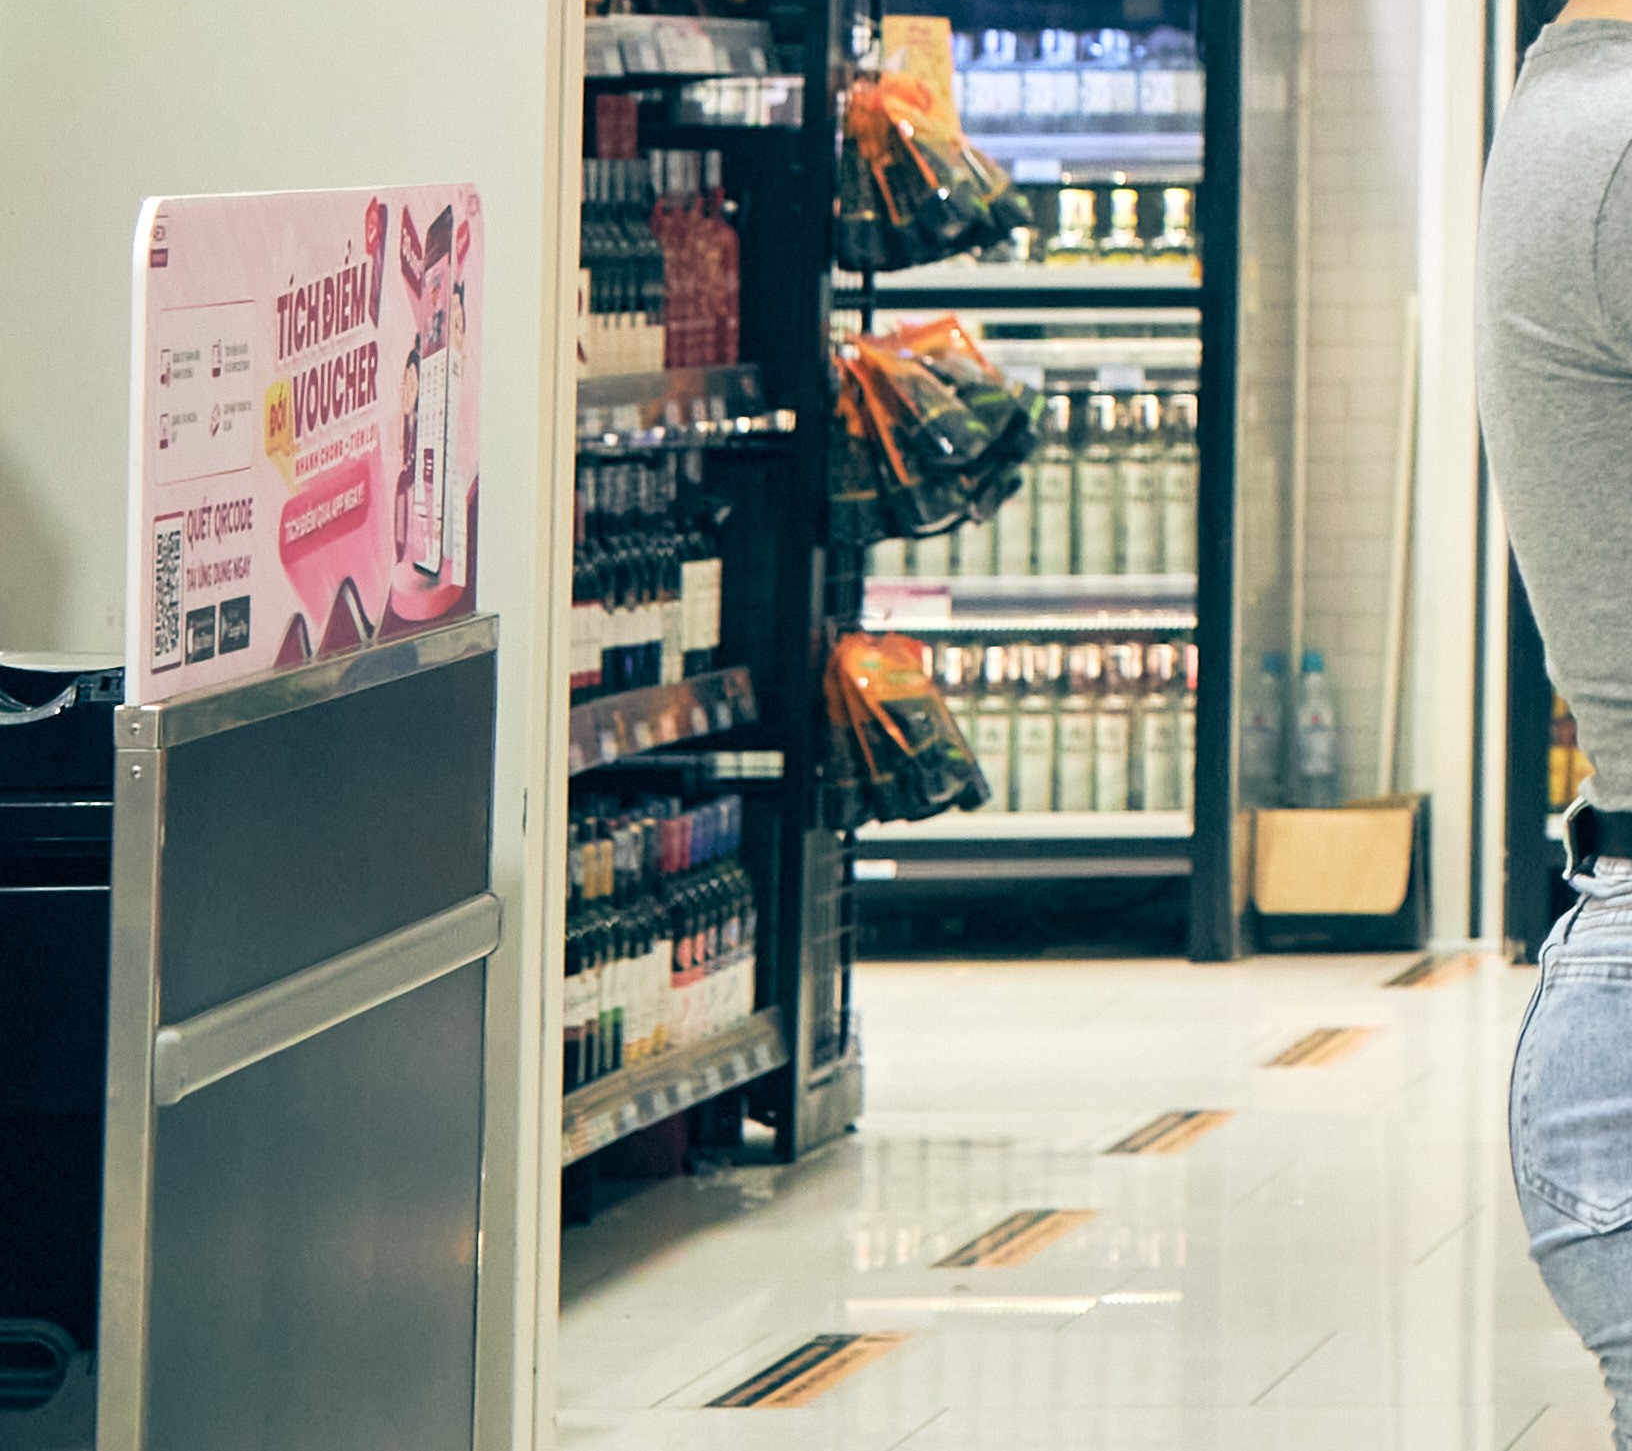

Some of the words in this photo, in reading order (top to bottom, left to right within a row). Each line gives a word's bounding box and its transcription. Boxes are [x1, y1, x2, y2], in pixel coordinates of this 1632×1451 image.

[276, 272, 322, 362] TÍCH
[321, 238, 368, 343] ĐIỂM
[292, 339, 380, 440] VOUCHER
[215, 496, 254, 545] QRCODE
